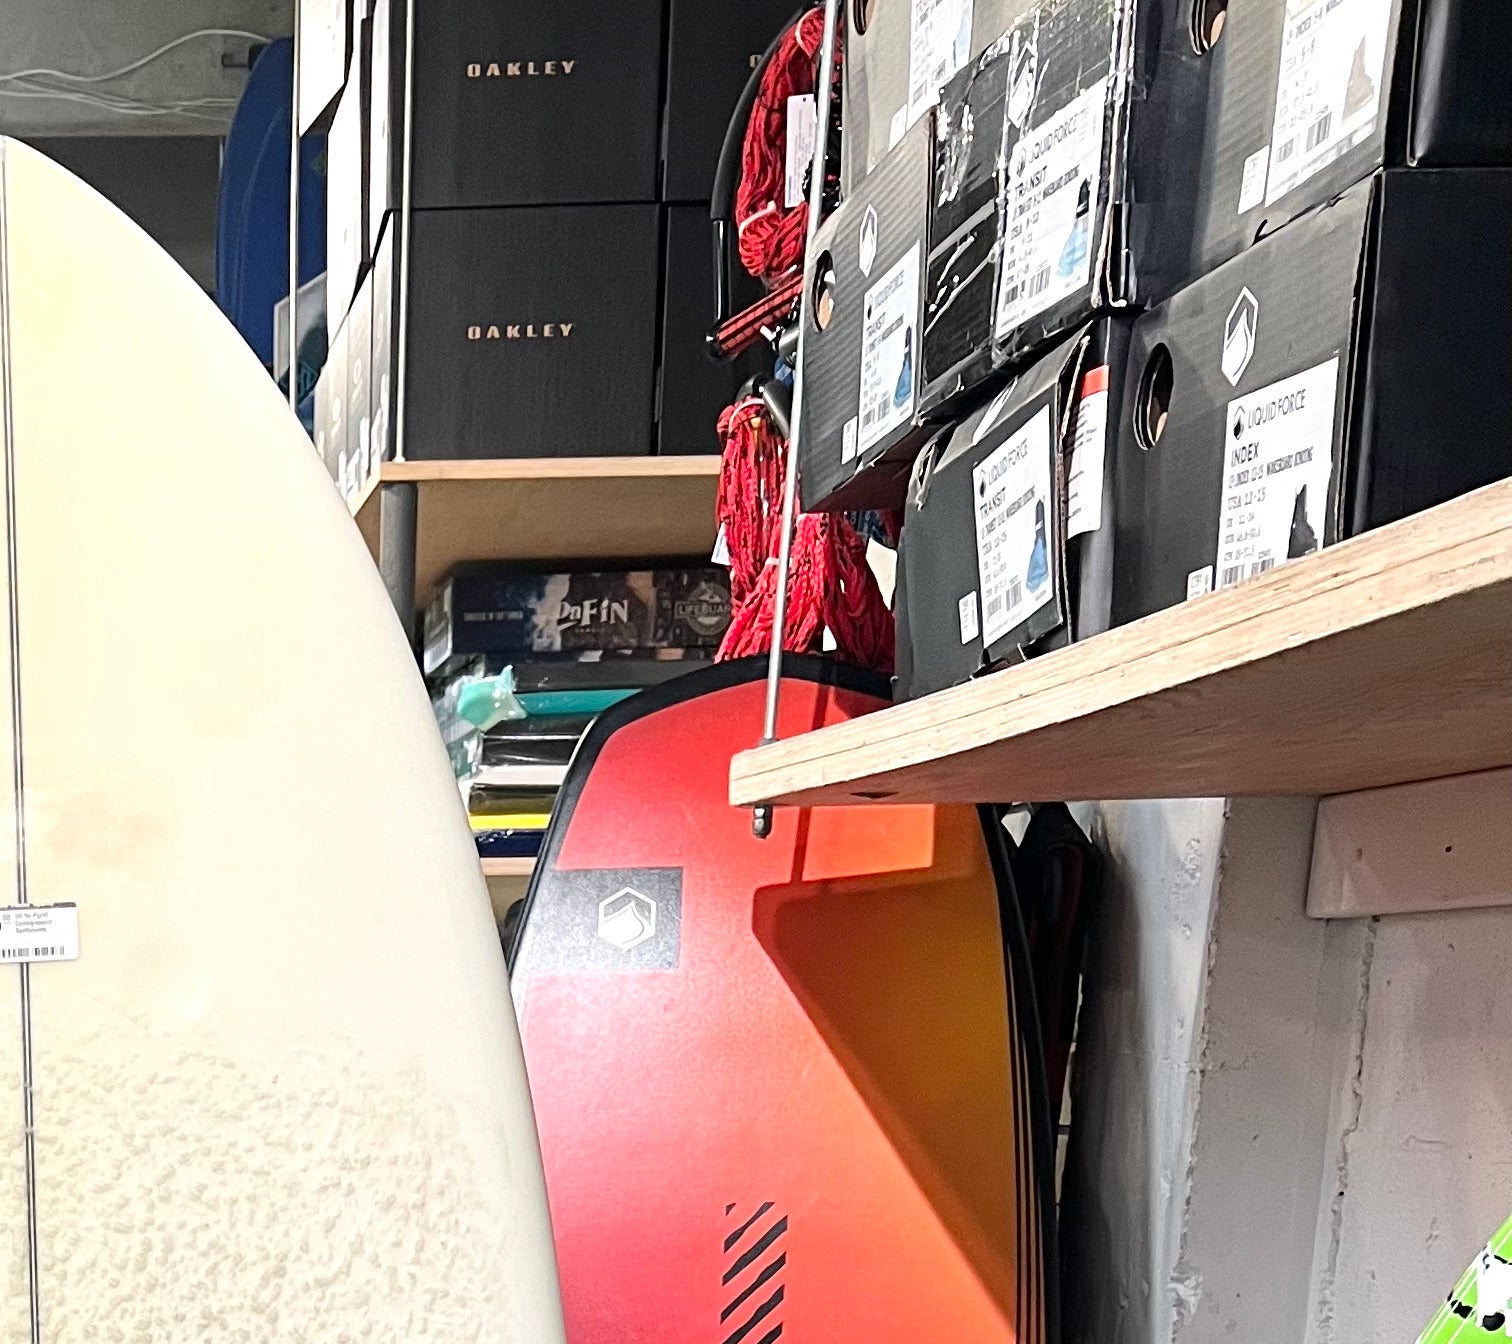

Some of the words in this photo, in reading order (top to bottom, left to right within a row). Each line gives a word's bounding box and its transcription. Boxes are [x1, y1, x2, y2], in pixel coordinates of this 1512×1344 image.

[467, 60, 575, 77] OAKLEY
[467, 323, 573, 340] OAKLEY
[1247, 401, 1277, 429] LIQUID
[1277, 389, 1306, 417] FORCE
[1230, 441, 1260, 467] INDEX
